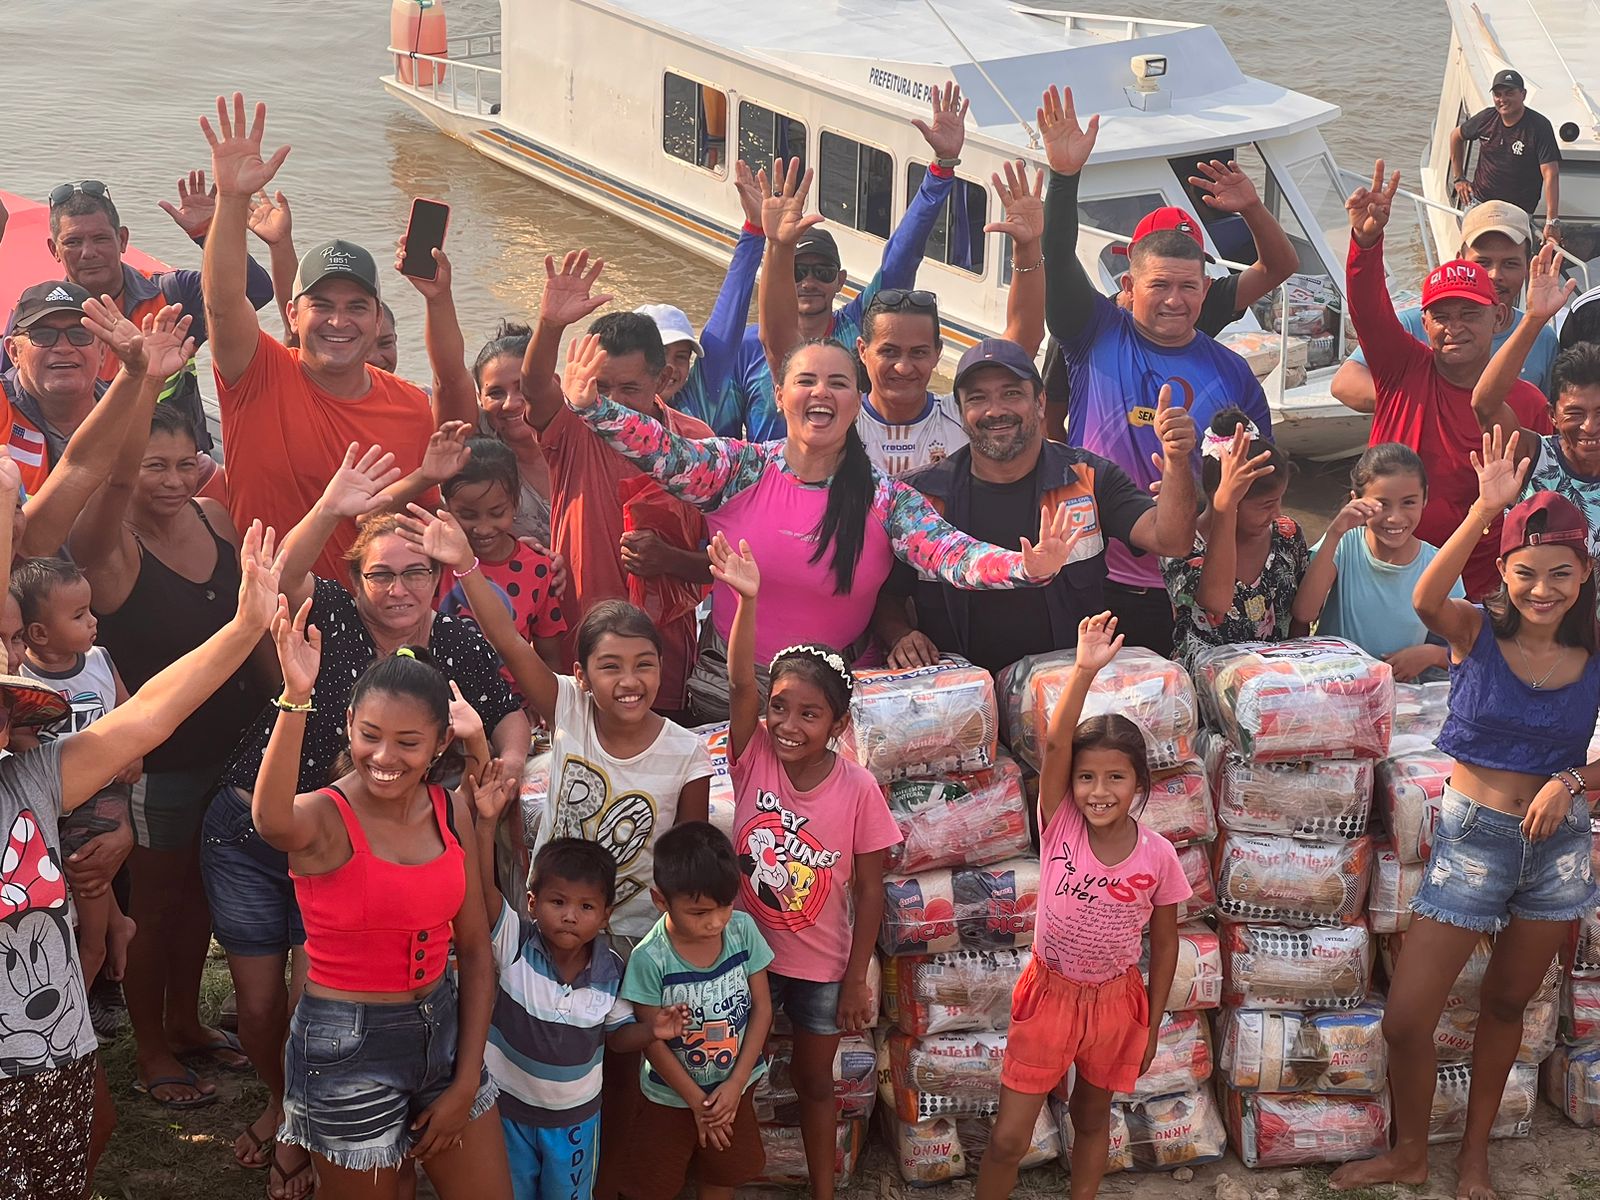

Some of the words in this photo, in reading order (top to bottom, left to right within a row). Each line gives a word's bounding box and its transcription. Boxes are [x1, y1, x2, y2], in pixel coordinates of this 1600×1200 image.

[868, 67, 911, 97] PREFEITURA
[912, 81, 922, 100] DE
[783, 830, 841, 868] TUNES
[1051, 842, 1077, 875] See
[1054, 873, 1099, 904] Later
[1083, 873, 1121, 890] you
[713, 989, 745, 1014] cars
[1437, 1032, 1475, 1050] ARNO
[1329, 1052, 1368, 1066] ARNO
[912, 1142, 952, 1157] ARNO
